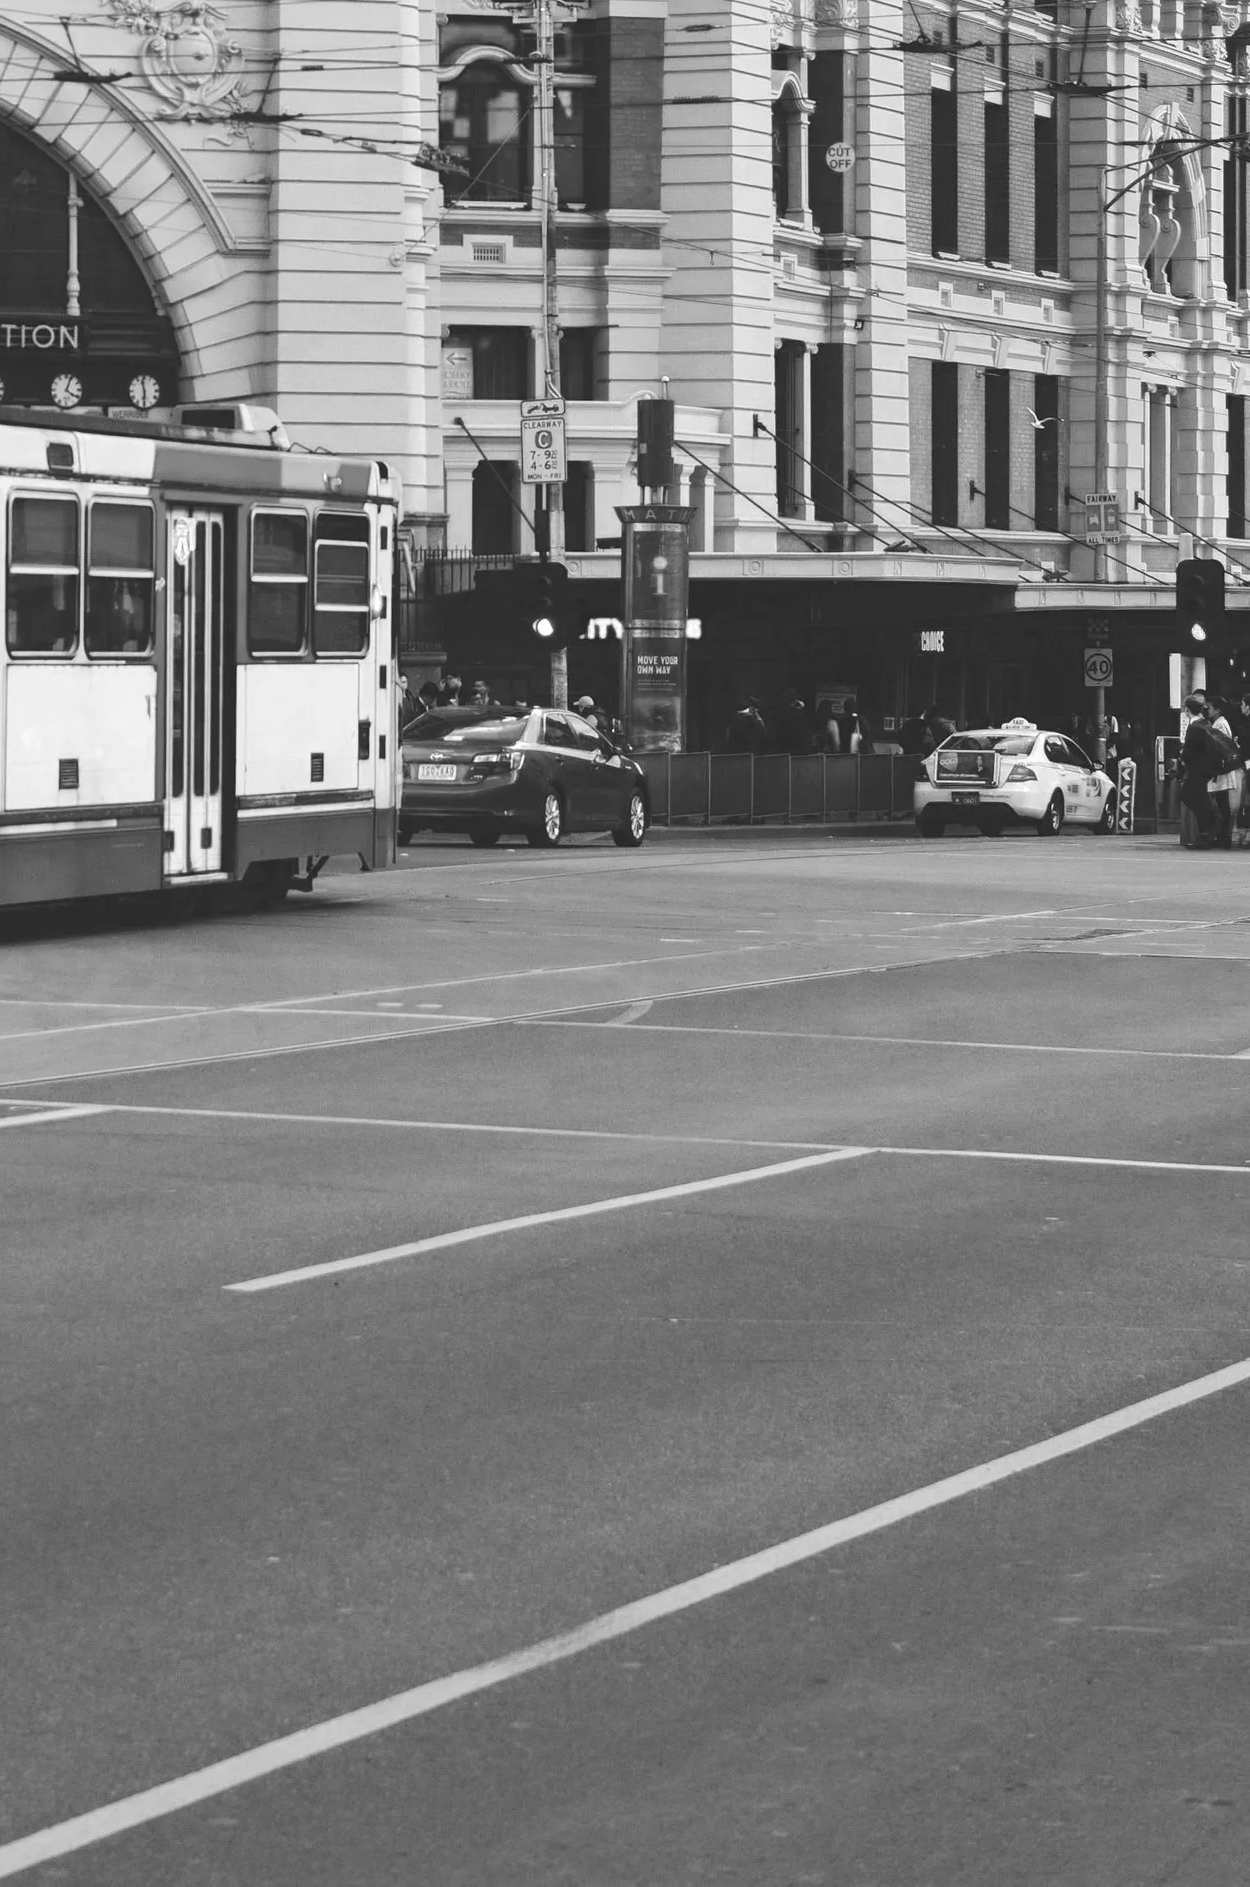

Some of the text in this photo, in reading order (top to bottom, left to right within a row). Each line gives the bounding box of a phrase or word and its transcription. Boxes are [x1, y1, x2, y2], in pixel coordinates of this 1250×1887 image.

[828, 147, 851, 157] CUT
[830, 159, 852, 169] OFF
[523, 421, 562, 430] CLEARWAY
[1087, 495, 1117, 503] FAIRWAY
[1101, 536, 1119, 544] TIMES
[637, 655, 679, 665] MOVE YOUR
[637, 665, 671, 675] OWN WAY
[1086, 660, 1109, 675] 40
